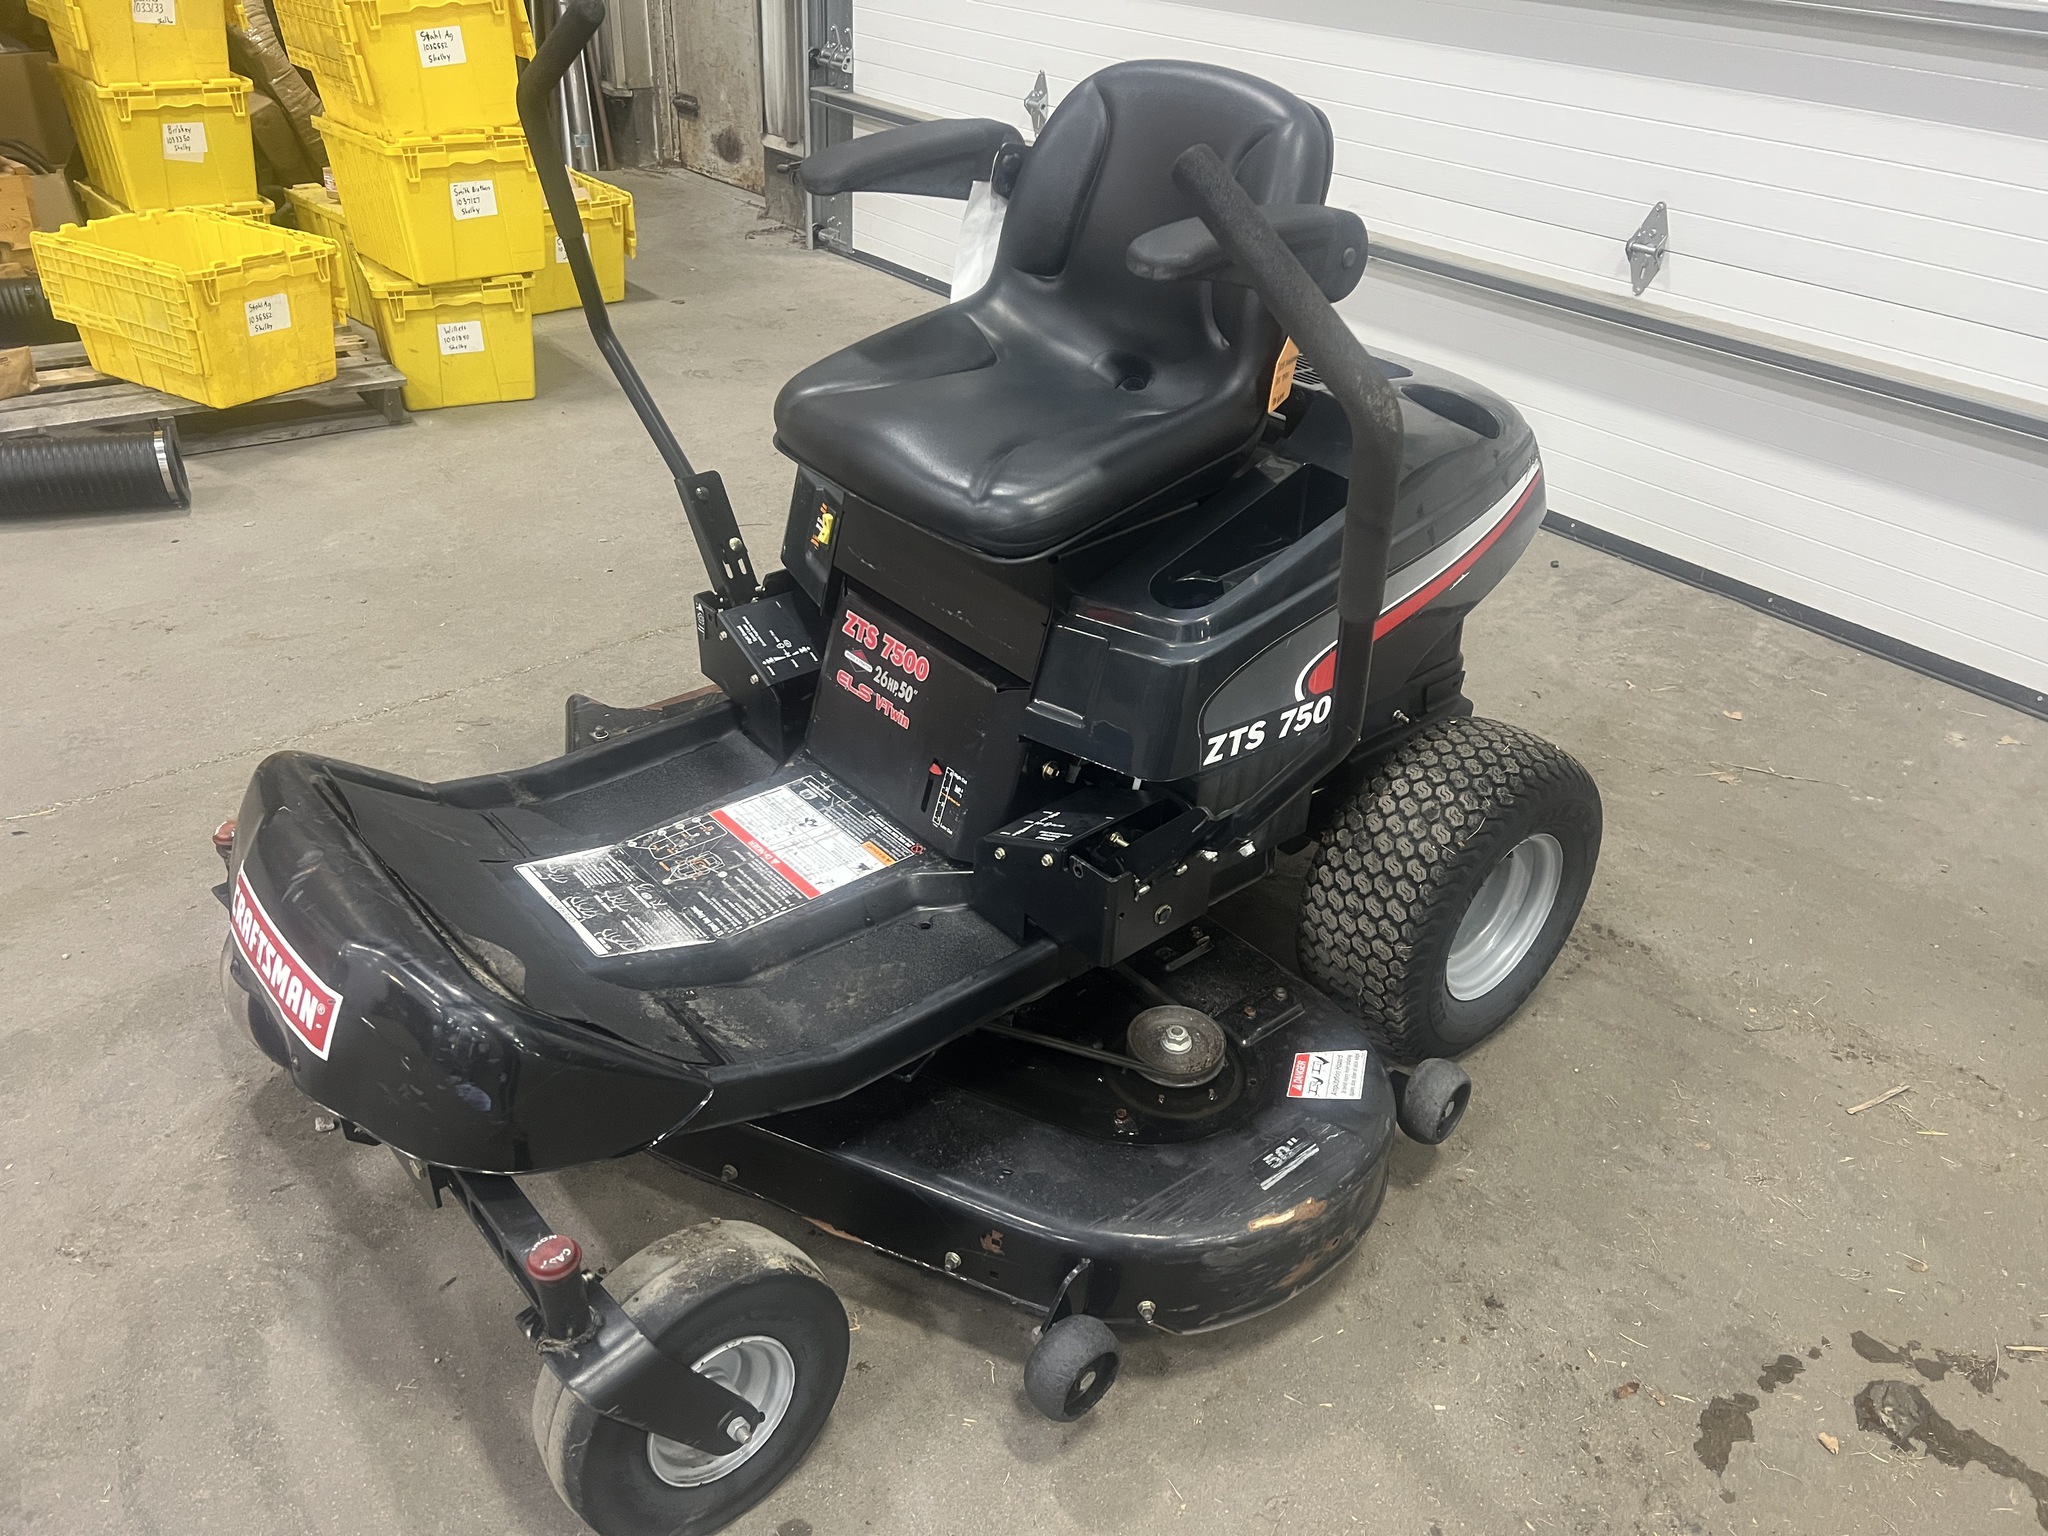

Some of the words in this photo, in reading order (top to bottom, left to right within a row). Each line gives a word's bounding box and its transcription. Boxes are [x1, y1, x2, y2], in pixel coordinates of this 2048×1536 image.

[842, 609, 879, 649] ZTS
[880, 633, 930, 682] 7500
[836, 669, 874, 703] ELS
[1202, 720, 1266, 766] ZTS
[1293, 1060, 1307, 1085] DANGER
